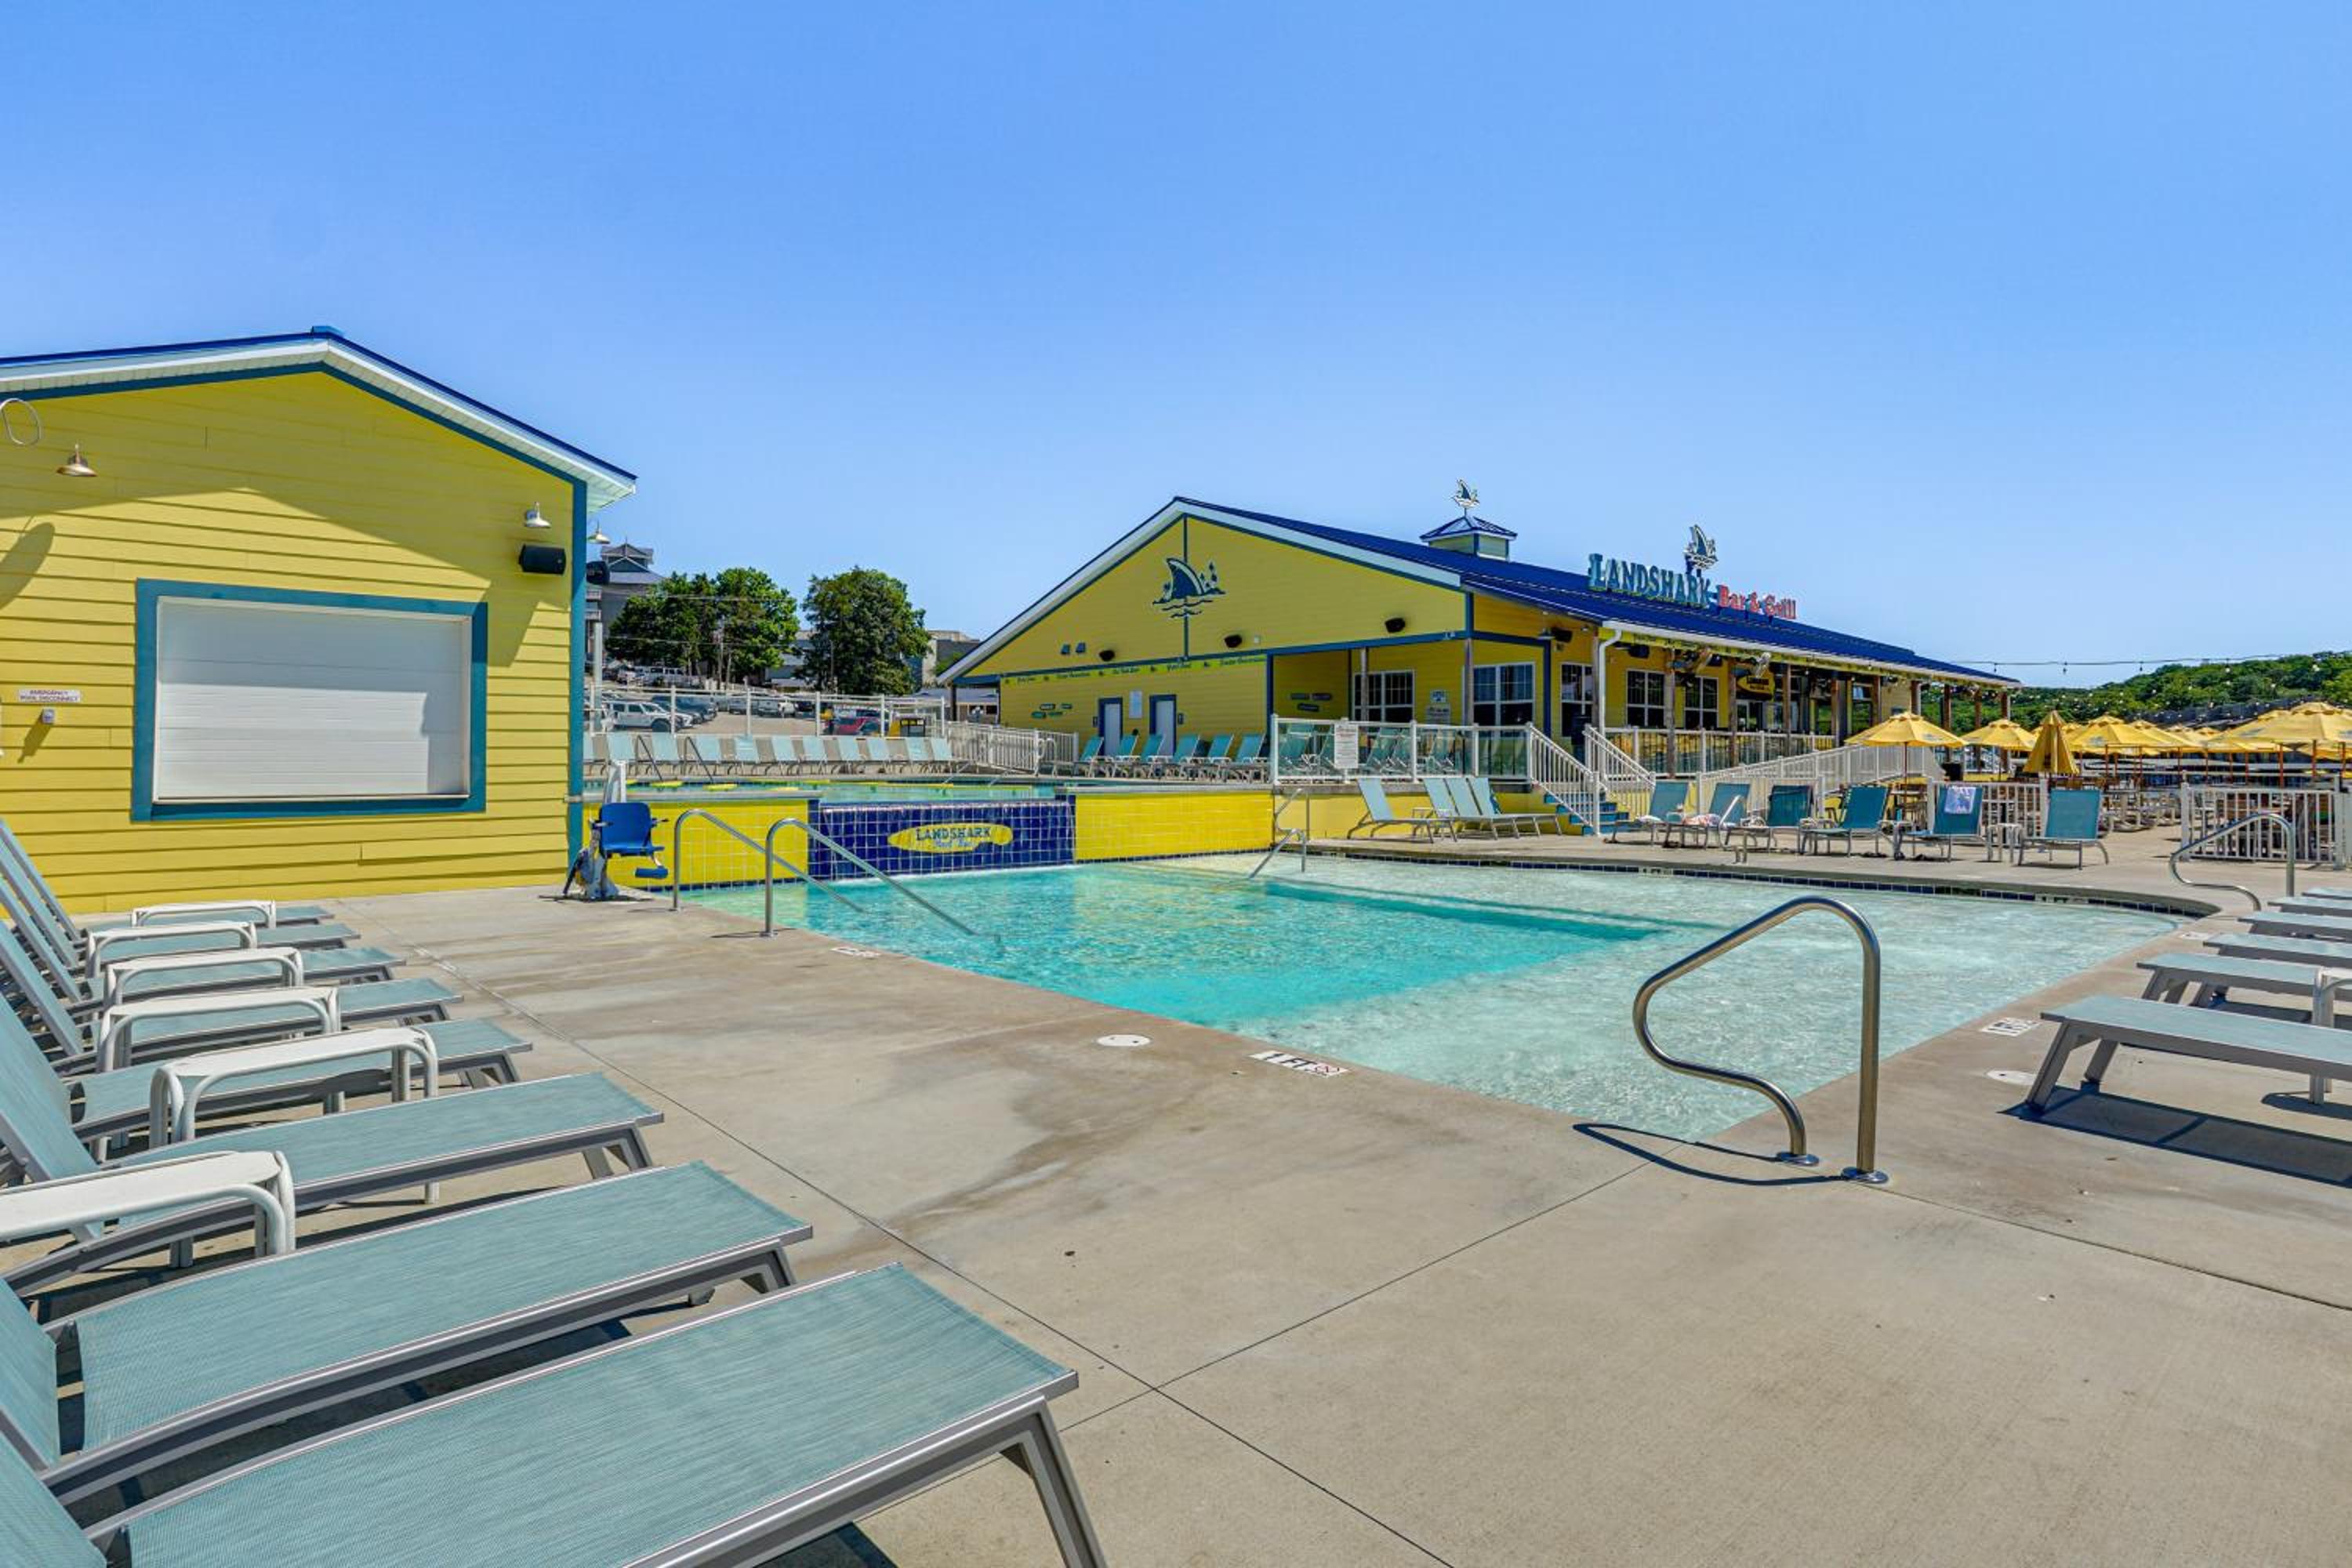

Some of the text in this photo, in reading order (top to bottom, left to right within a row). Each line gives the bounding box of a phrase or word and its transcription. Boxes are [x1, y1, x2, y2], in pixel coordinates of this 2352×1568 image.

[1588, 553, 1711, 608] LANDSHARK
[1717, 585, 1746, 610] Bar
[1748, 592, 1761, 613] &
[1764, 594, 1796, 619] Grill
[916, 827, 990, 840] LANDSHARK
